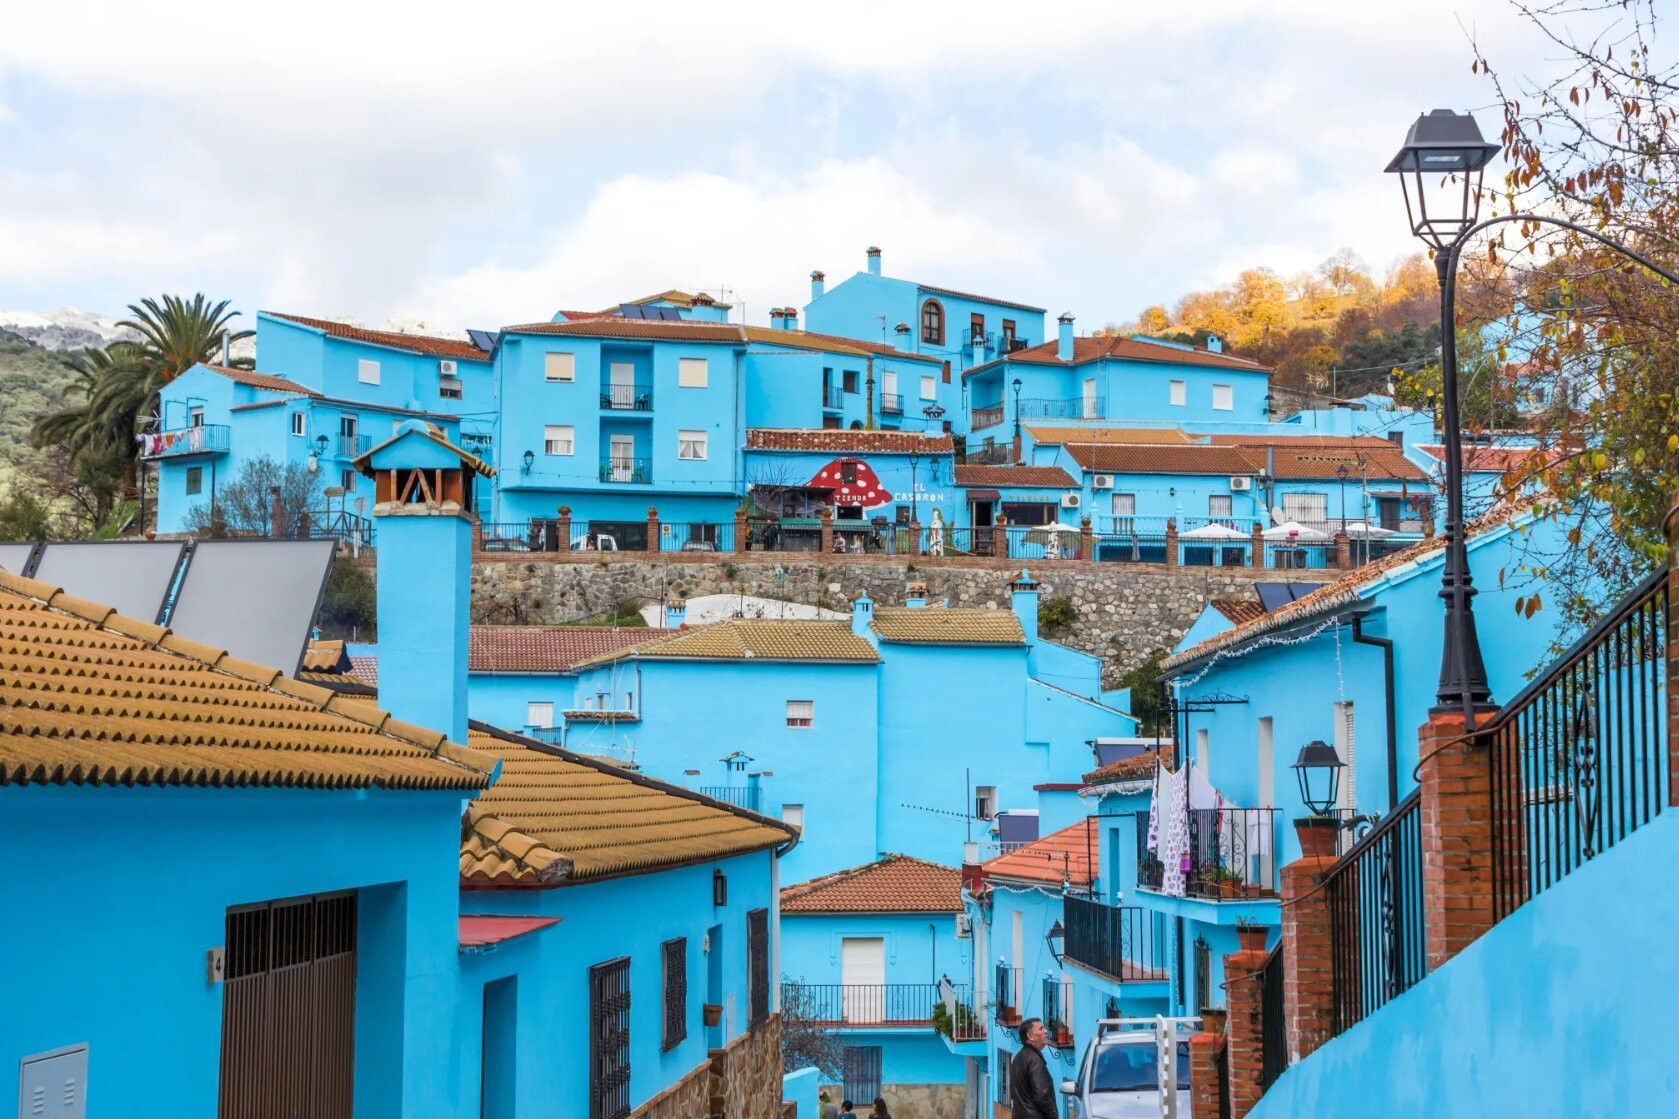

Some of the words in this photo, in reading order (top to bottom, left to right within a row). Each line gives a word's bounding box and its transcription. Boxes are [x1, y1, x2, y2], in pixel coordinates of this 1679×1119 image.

[914, 483, 925, 492] EL
[894, 493, 944, 502] CASARON
[215, 956, 222, 973] 4
